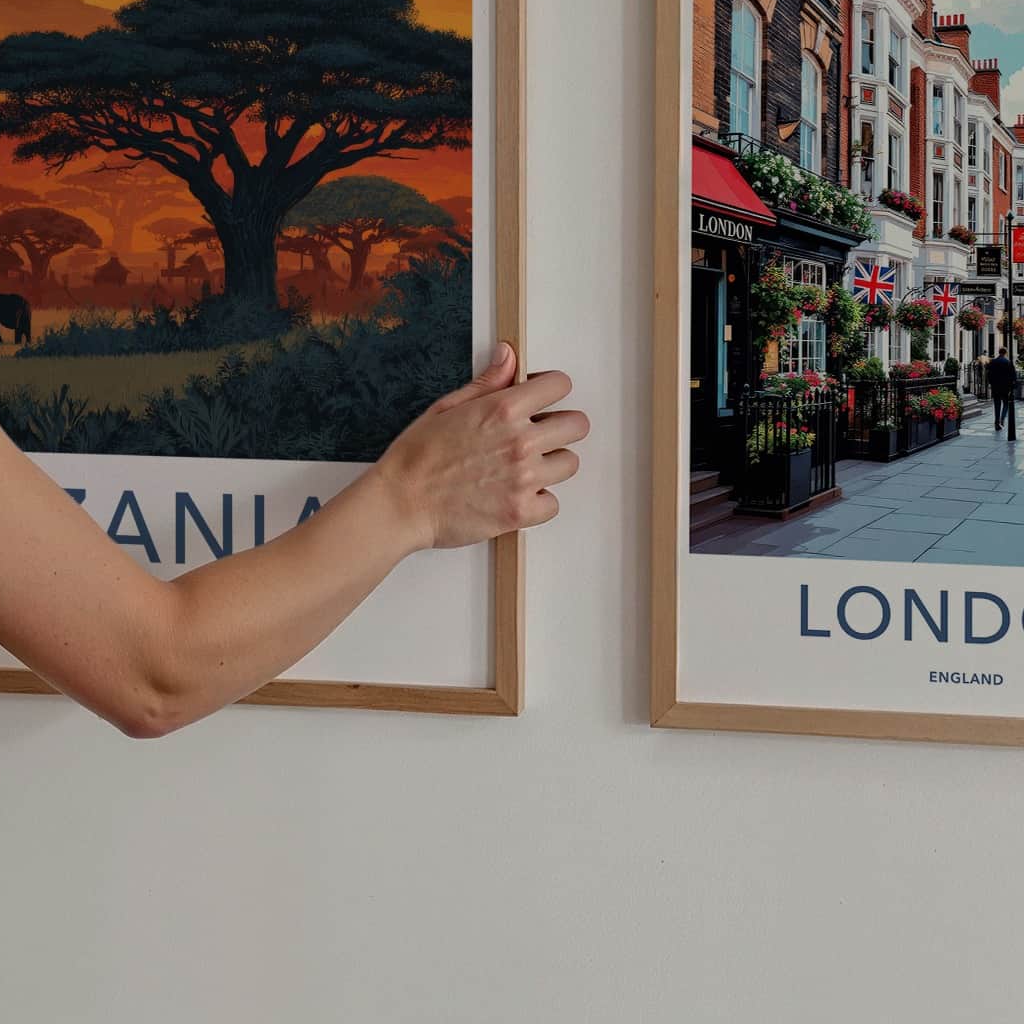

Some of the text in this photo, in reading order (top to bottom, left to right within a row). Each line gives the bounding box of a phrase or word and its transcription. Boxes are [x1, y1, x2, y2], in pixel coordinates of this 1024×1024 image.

[698, 213, 753, 242] LONDON
[800, 584, 1024, 644] LOND
[929, 671, 1004, 686] ENGLAND
